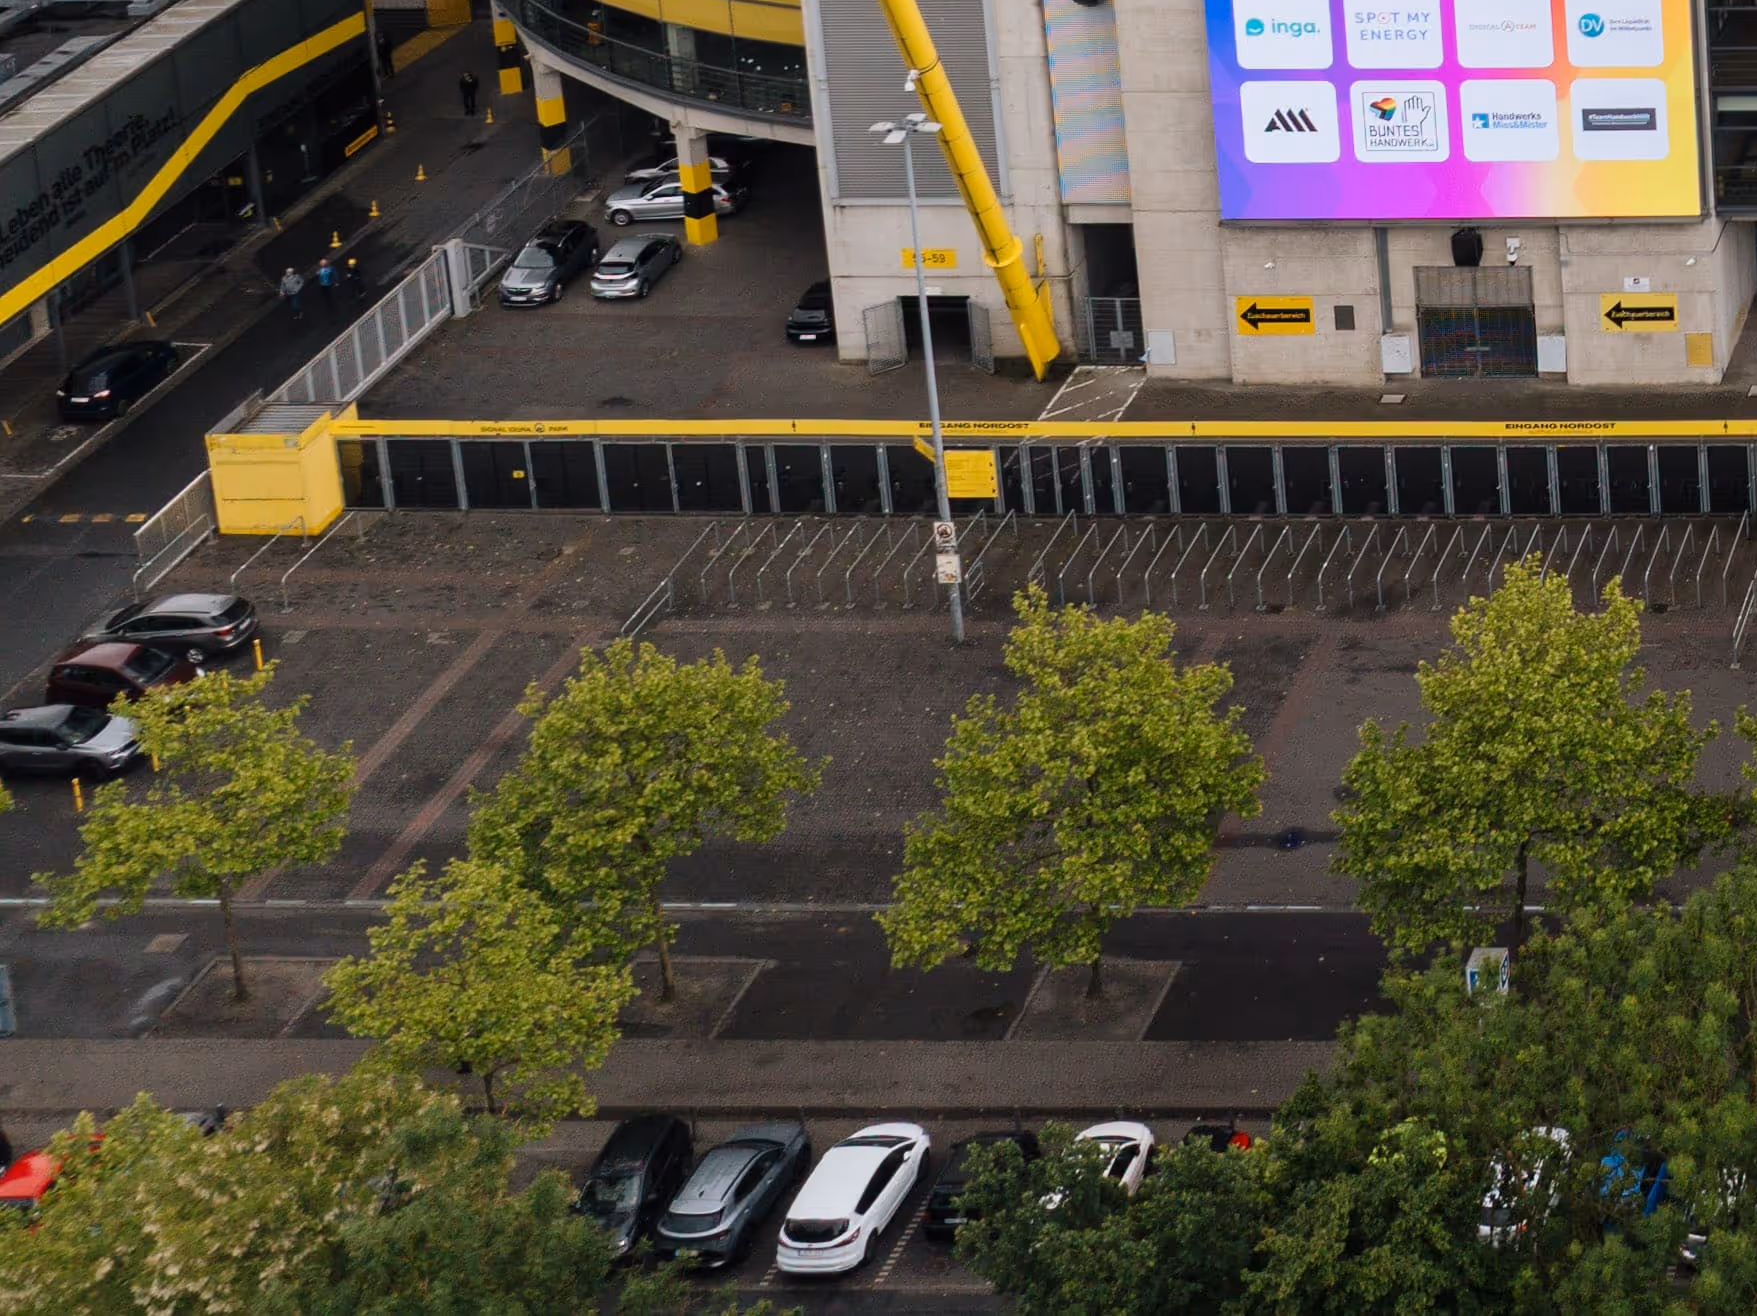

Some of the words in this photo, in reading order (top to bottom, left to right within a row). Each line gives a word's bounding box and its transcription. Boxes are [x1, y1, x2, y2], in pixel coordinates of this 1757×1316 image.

[1354, 11, 1400, 24] SPOT
[1407, 11, 1431, 24] MY
[1272, 18, 1320, 38] inga.
[1580, 19, 1603, 32] DV
[1360, 29, 1428, 41] ENERGY
[1492, 112, 1542, 121] Handwerks
[1369, 125, 1419, 137] BUNTES
